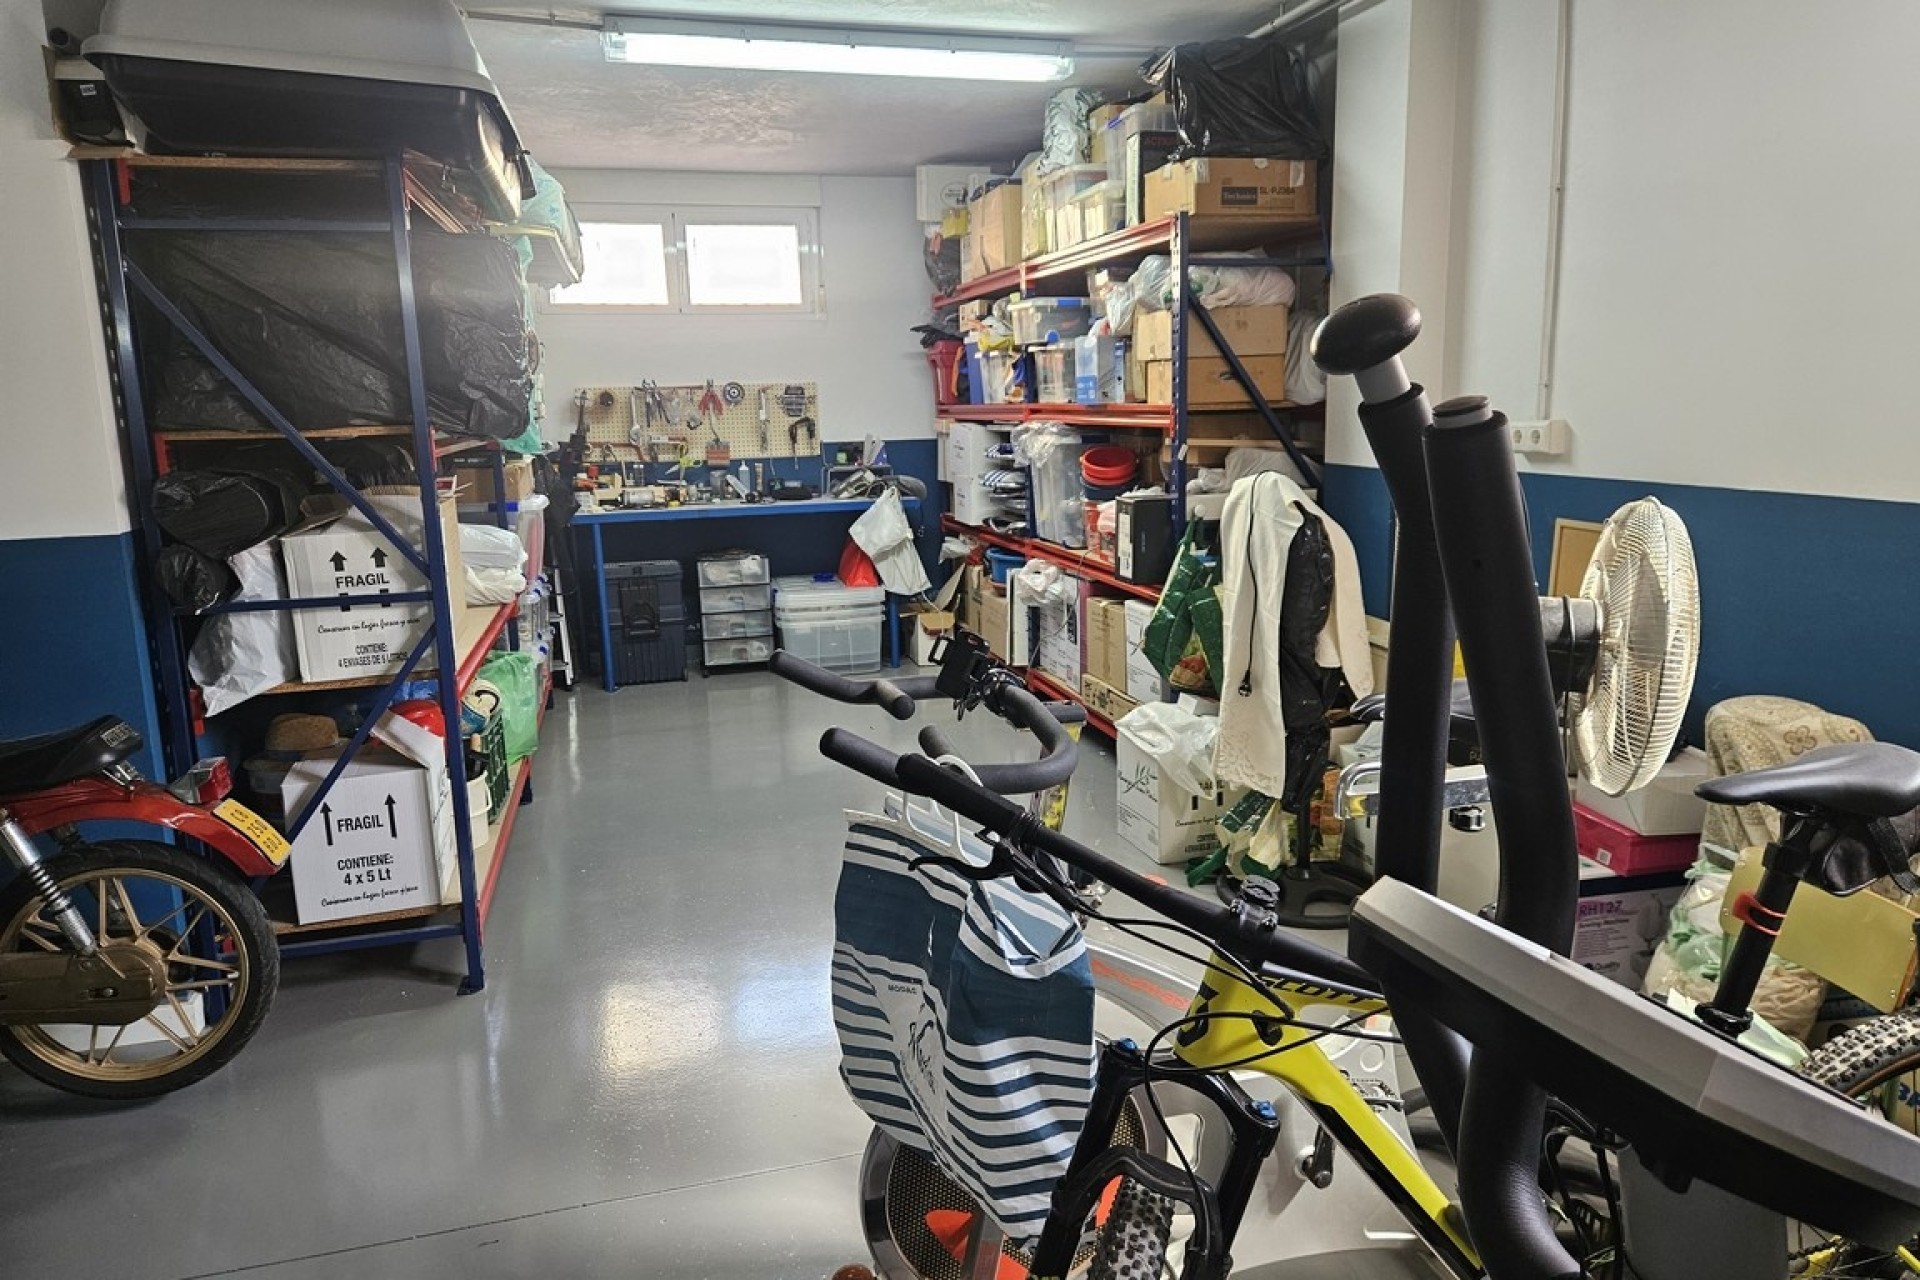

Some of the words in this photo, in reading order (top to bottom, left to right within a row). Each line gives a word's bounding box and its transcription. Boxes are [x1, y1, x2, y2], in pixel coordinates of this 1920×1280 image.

[335, 572, 390, 589] FRAGIL
[337, 814, 384, 833] FRAGIL
[337, 852, 395, 872] CONTIENE:
[343, 872, 353, 886] 4
[355, 873, 364, 885] x
[366, 869, 376, 883] 5
[378, 867, 392, 881] Lt
[1258, 974, 1379, 1005] SCOTT
